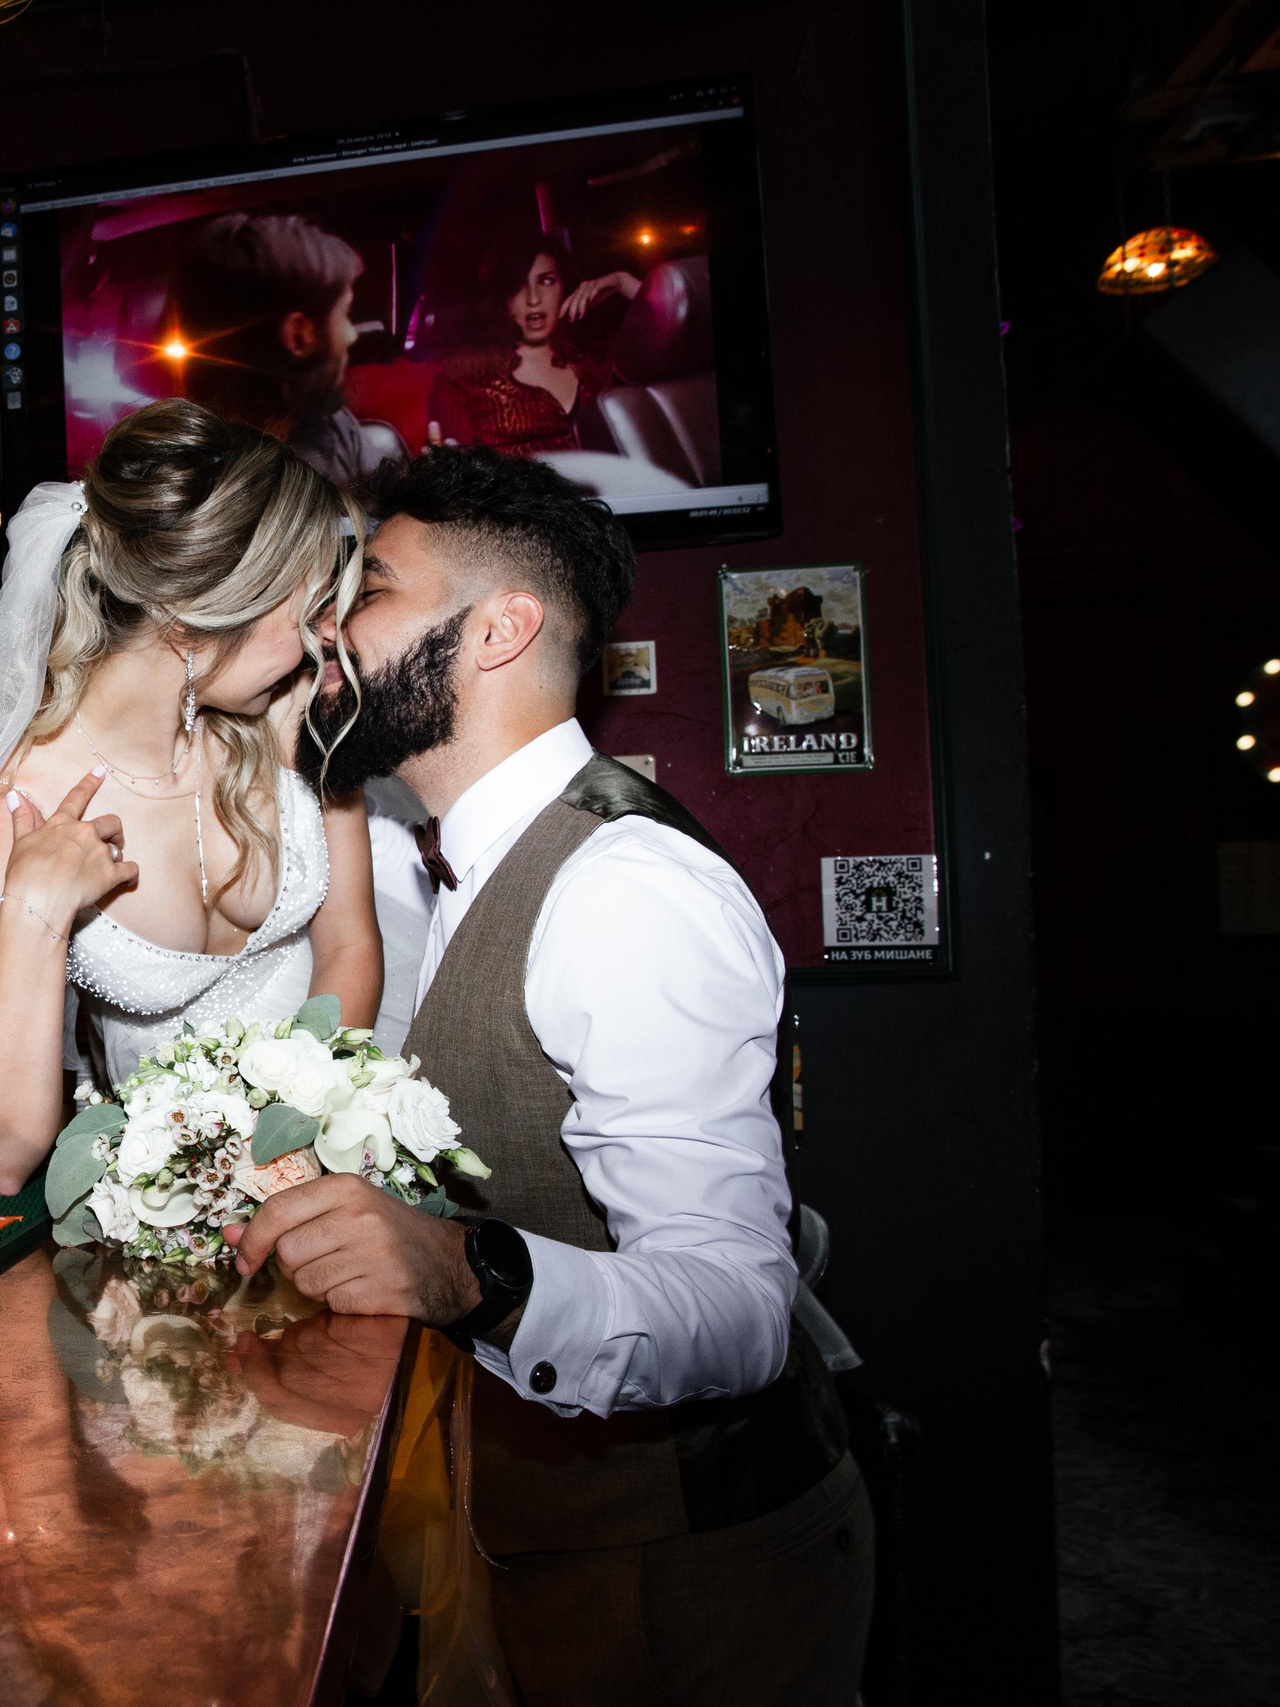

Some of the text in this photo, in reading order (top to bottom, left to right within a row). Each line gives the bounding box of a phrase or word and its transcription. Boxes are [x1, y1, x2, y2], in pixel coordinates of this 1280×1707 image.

[742, 731, 859, 753] IRELAND
[830, 949, 933, 961] НА ЗУБ МИШАНЕ
